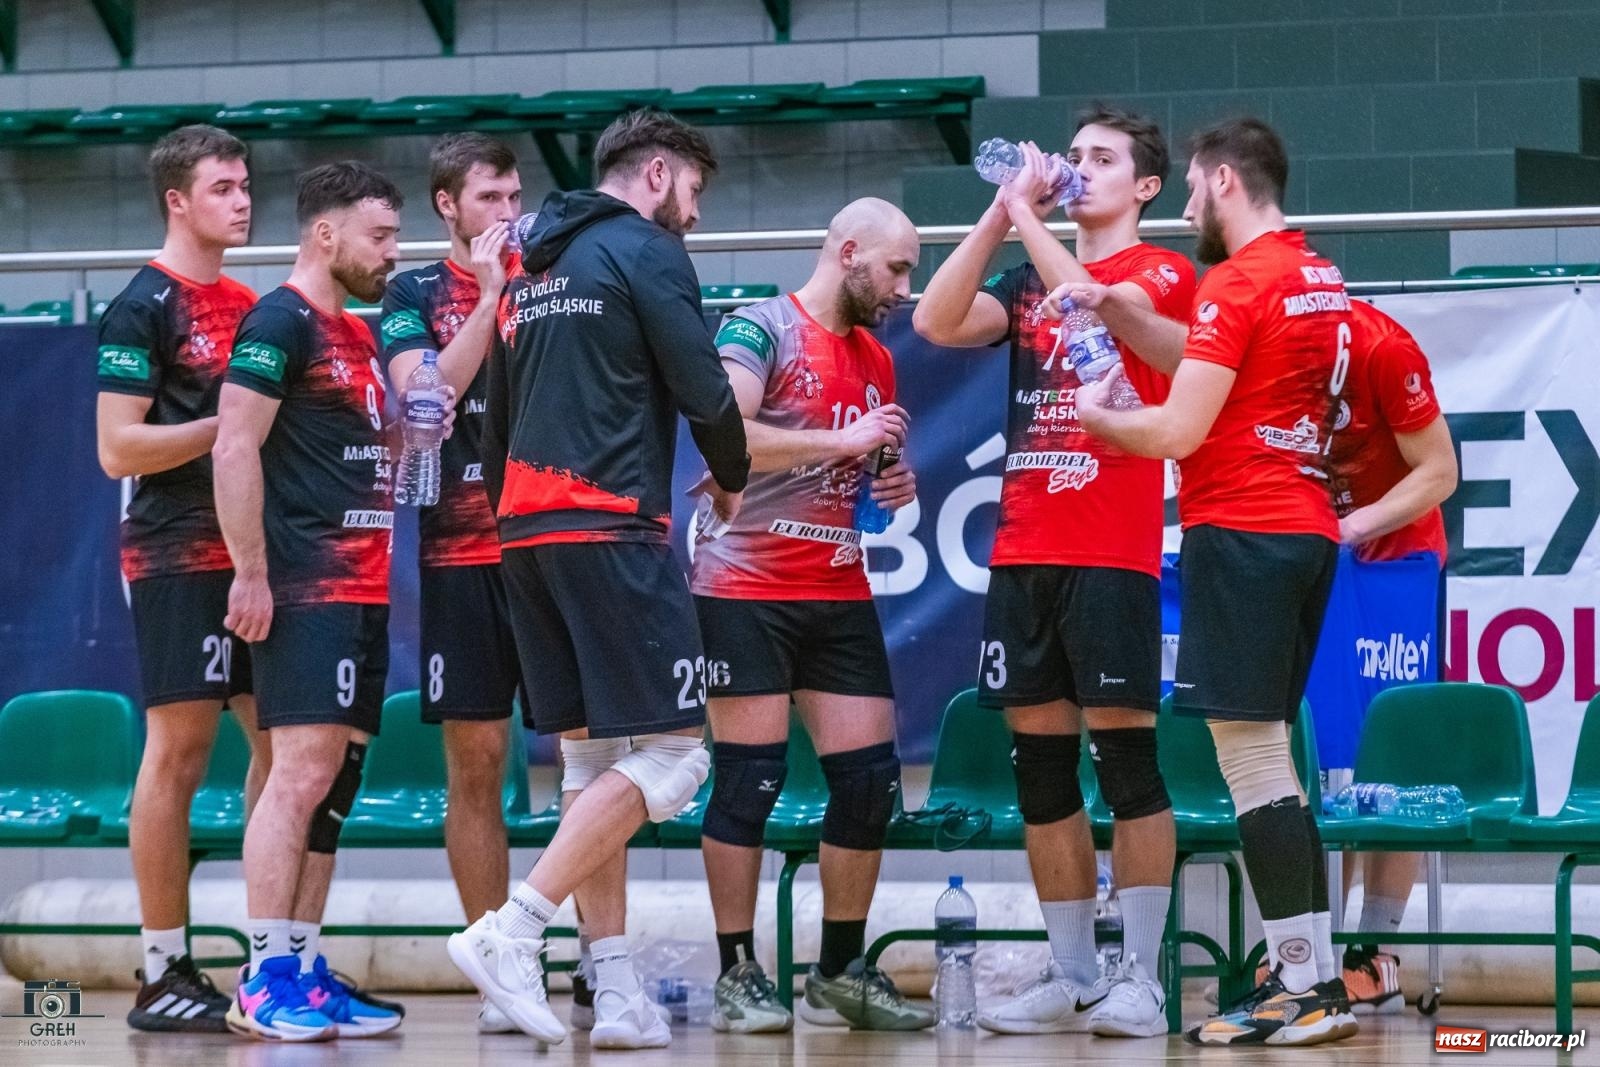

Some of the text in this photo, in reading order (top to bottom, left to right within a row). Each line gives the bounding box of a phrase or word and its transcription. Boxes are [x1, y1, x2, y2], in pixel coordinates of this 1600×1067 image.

[516, 277, 569, 304] KS VOLLEY
[550, 296, 603, 316] ŚLĄSKIE
[1042, 327, 1074, 371] 7
[1330, 322, 1351, 396] 6
[366, 383, 381, 431] 9
[1050, 462, 1096, 491] Styl
[203, 634, 232, 683] 20
[428, 652, 445, 703] 8
[673, 655, 706, 710] 23
[708, 660, 731, 687] 16
[337, 658, 356, 708] 9
